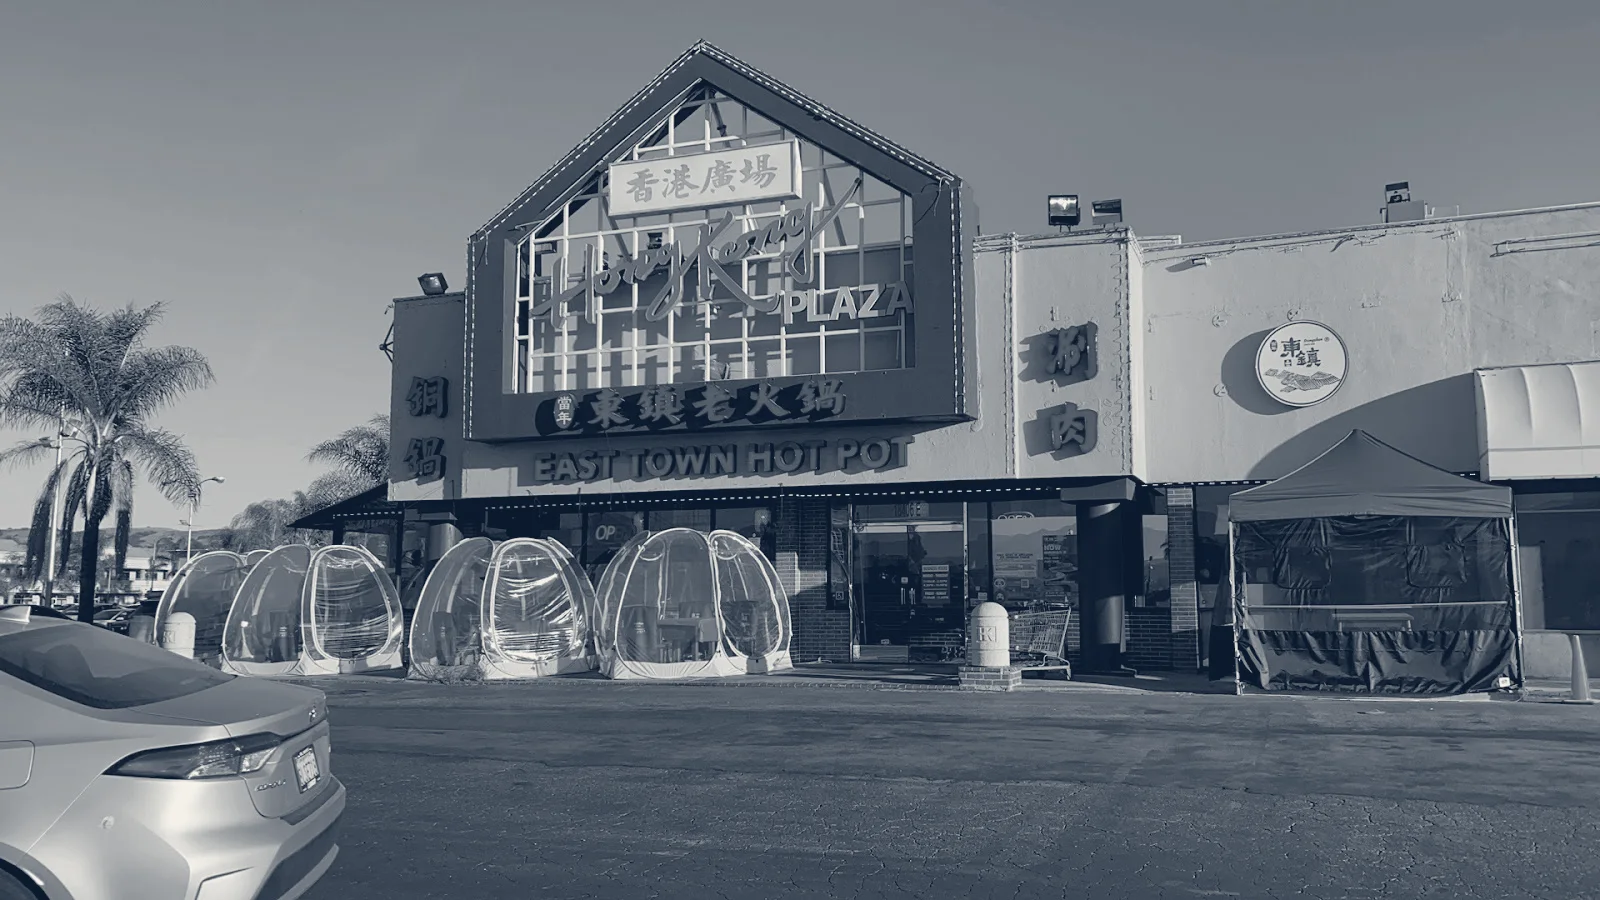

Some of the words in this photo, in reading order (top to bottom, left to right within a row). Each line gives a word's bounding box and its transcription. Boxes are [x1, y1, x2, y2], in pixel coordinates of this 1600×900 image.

[626, 153, 778, 203] 香港廣場
[529, 239, 688, 330] Hong
[697, 177, 862, 312] Kong
[783, 280, 914, 325] PLAZA
[556, 396, 572, 425] 當年
[534, 449, 619, 482] EAST
[622, 443, 737, 478] TOWN
[747, 439, 825, 473] HOT
[837, 435, 915, 469] POT
